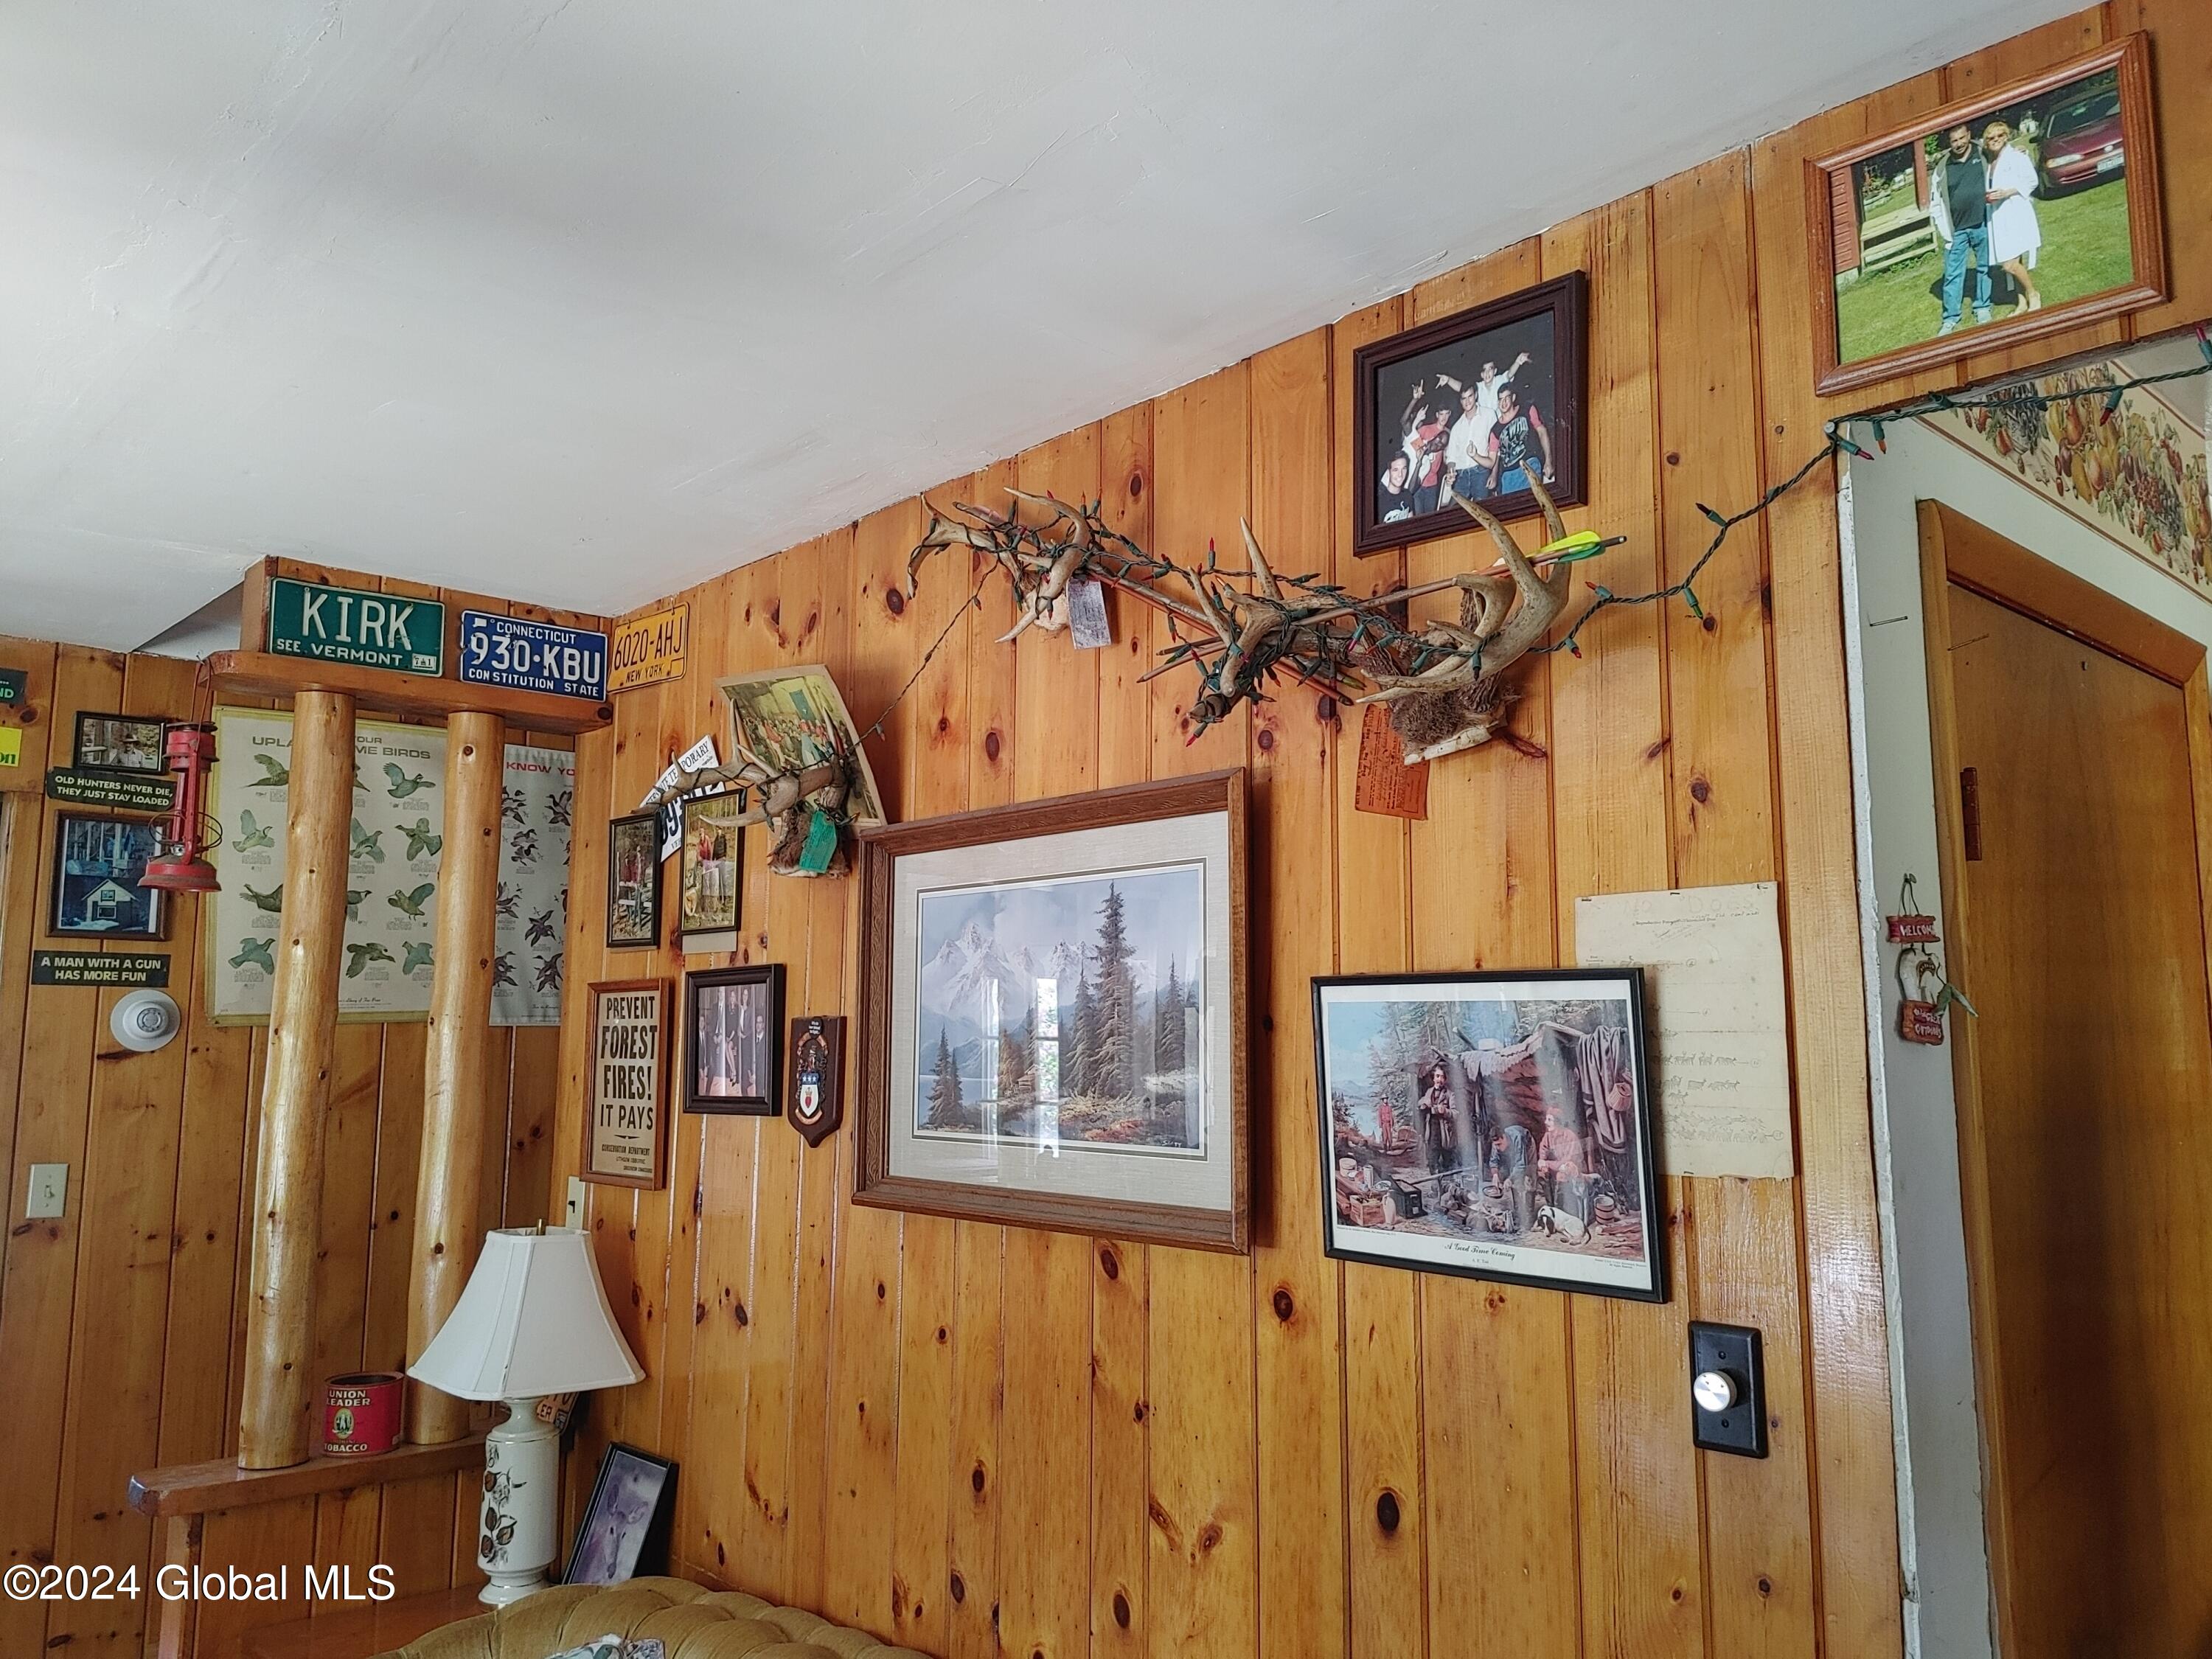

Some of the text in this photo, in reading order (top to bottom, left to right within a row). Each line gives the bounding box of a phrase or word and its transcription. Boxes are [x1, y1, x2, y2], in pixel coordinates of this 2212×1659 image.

[302, 591, 414, 650] KIRK
[496, 622, 577, 644] CONNECTICUT
[613, 616, 684, 670] 6020-AHJ
[276, 639, 403, 666] SEE VERMONT
[626, 664, 663, 683] NEW YORK
[564, 683, 599, 696] STATE
[253, 736, 431, 759] UPLA ME BIRDS
[355, 736, 382, 744] OUR
[507, 762, 575, 776] KNOW YO
[55, 776, 173, 797] OLD HUNTERS NEVER DIE,
[57, 786, 170, 806] THEY JUST STAY LOADED
[41, 957, 161, 970] A MAN WITH A GUN
[55, 970, 146, 981] HAS MORE FUN
[606, 996, 655, 1020] PREVENT
[600, 1025, 658, 1060] FOREST
[603, 1065, 652, 1101] FIRES!
[600, 1104, 653, 1130] IT PAYS
[1491, 1248, 1516, 1261] Coming
[327, 1398, 371, 1406] LEADER
[324, 1443, 368, 1452] TOBACCO
